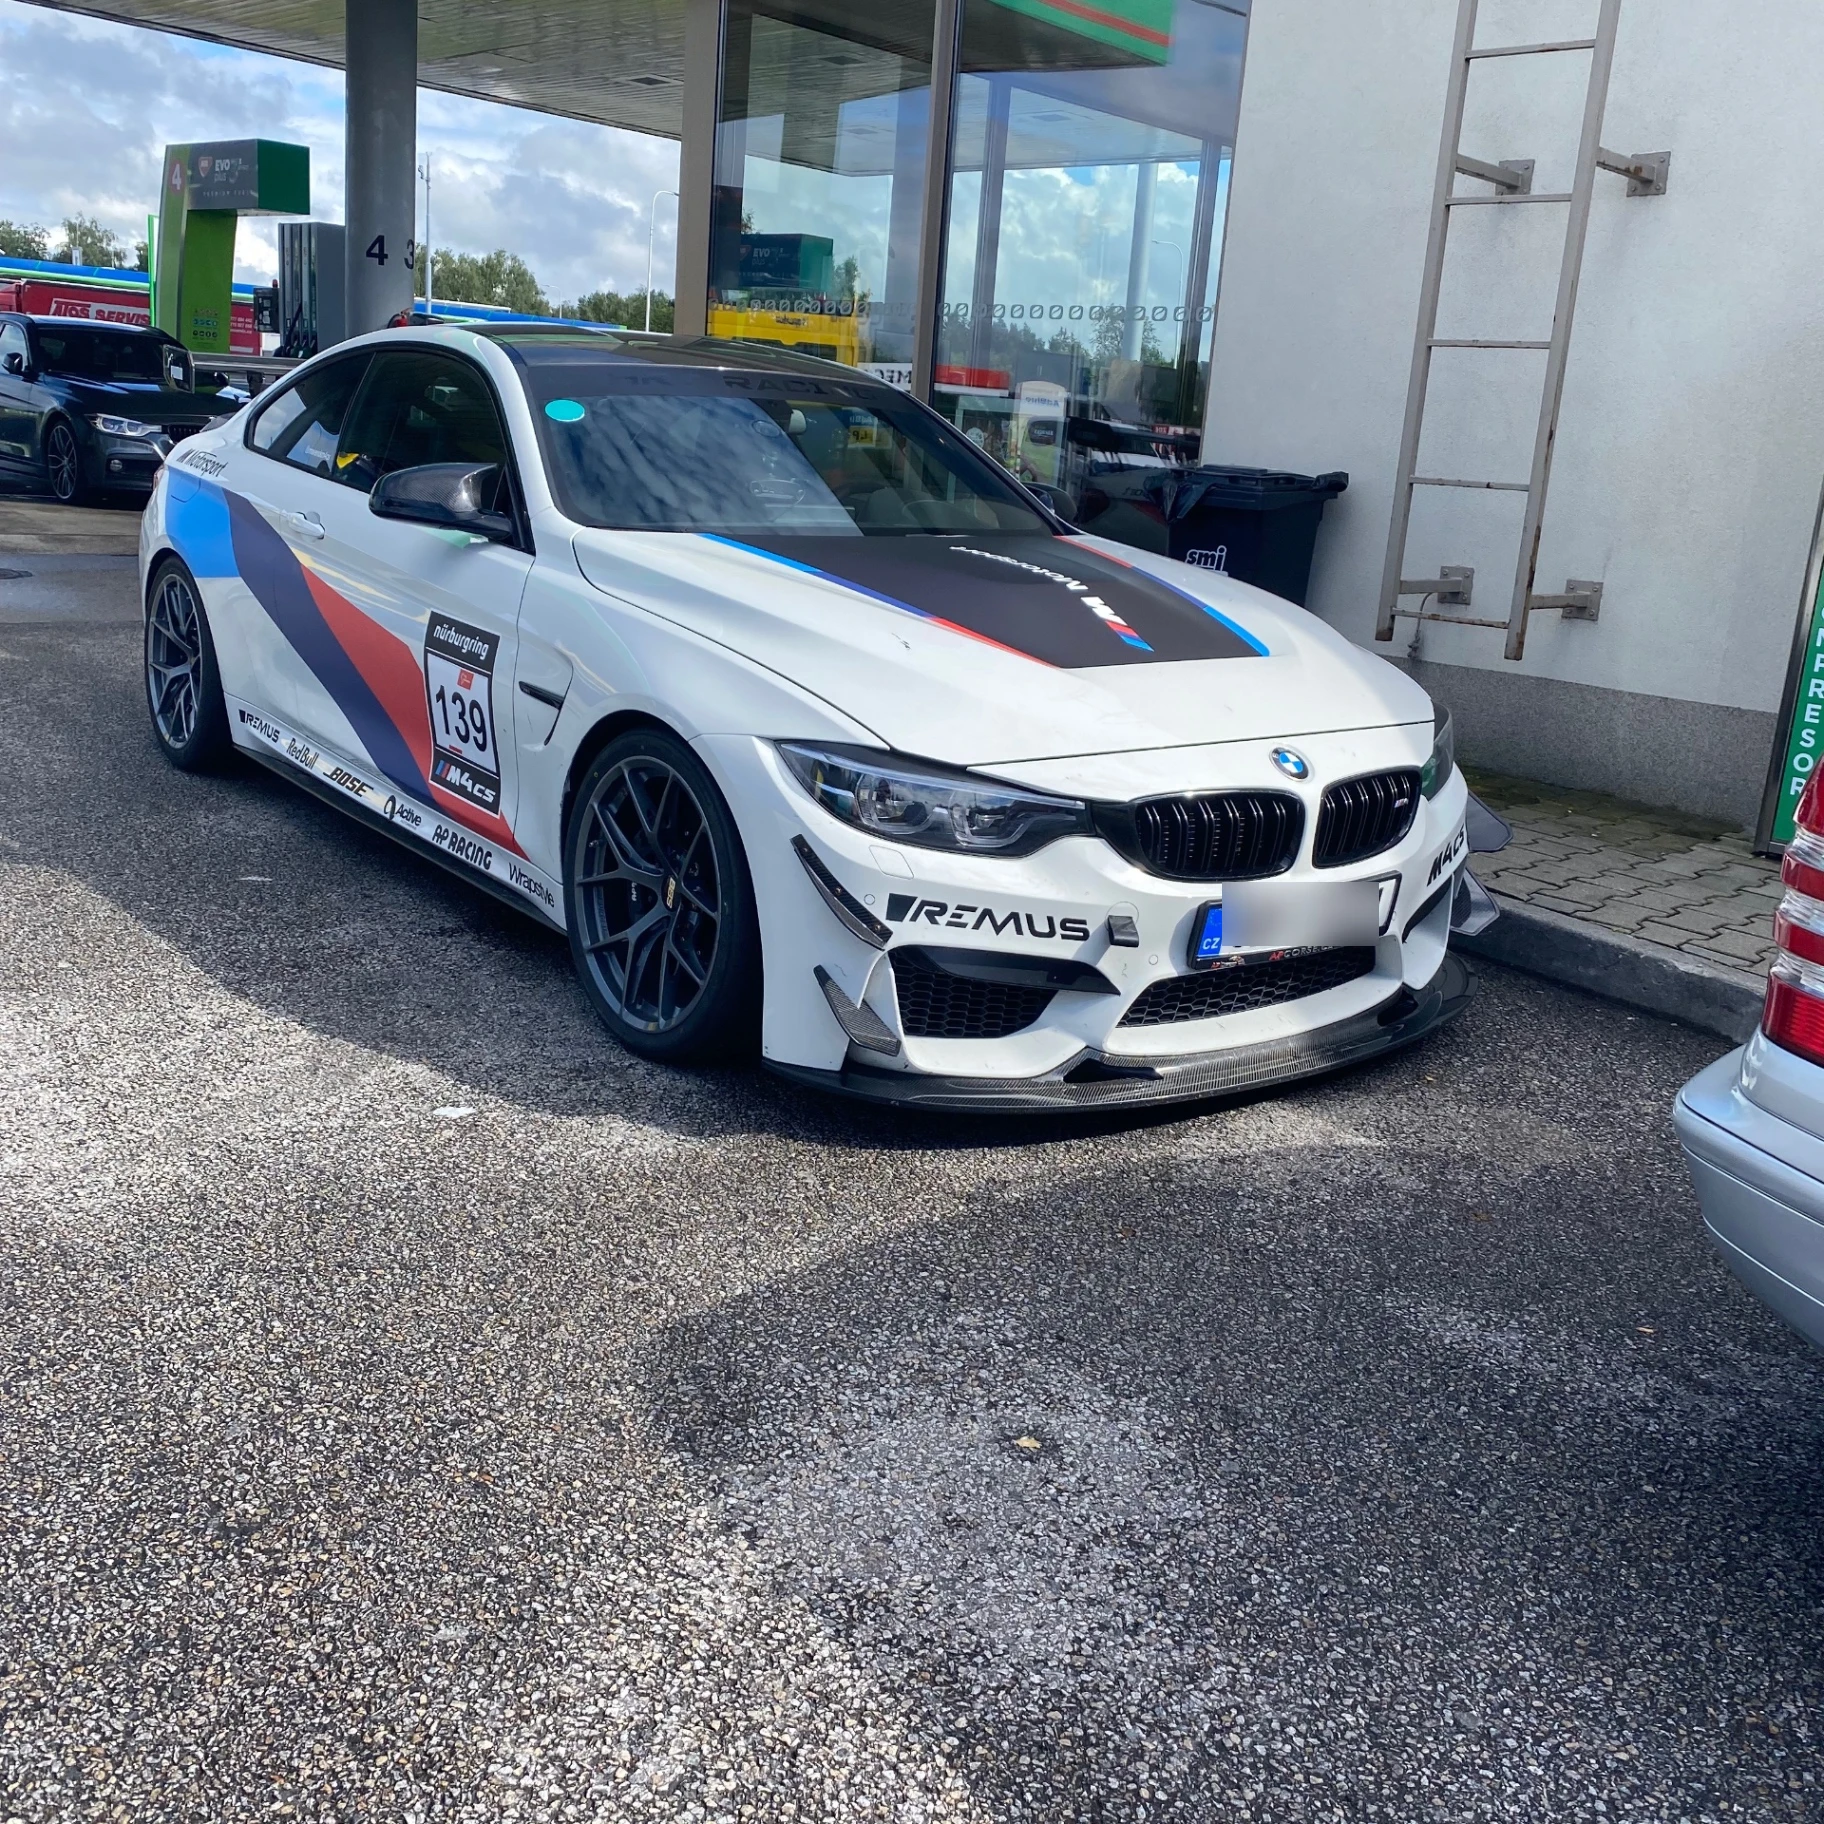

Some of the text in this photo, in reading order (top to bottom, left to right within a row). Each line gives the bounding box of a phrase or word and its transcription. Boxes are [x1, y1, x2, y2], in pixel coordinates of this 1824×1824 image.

[172, 163, 182, 191] 4
[215, 159, 230, 171] EVO
[366, 235, 388, 266] 4
[433, 623, 490, 660] nürburgring
[435, 684, 488, 753] 139
[1788, 607, 1824, 796] PRESOR
[246, 712, 281, 743] REMUS
[323, 766, 370, 798] BOSE
[395, 803, 422, 827] Active
[432, 824, 449, 845] AP
[447, 831, 493, 871] RACING
[508, 862, 555, 908] Wrapstyle
[908, 898, 1091, 942] REMUS
[1202, 937, 1220, 950] CZ
